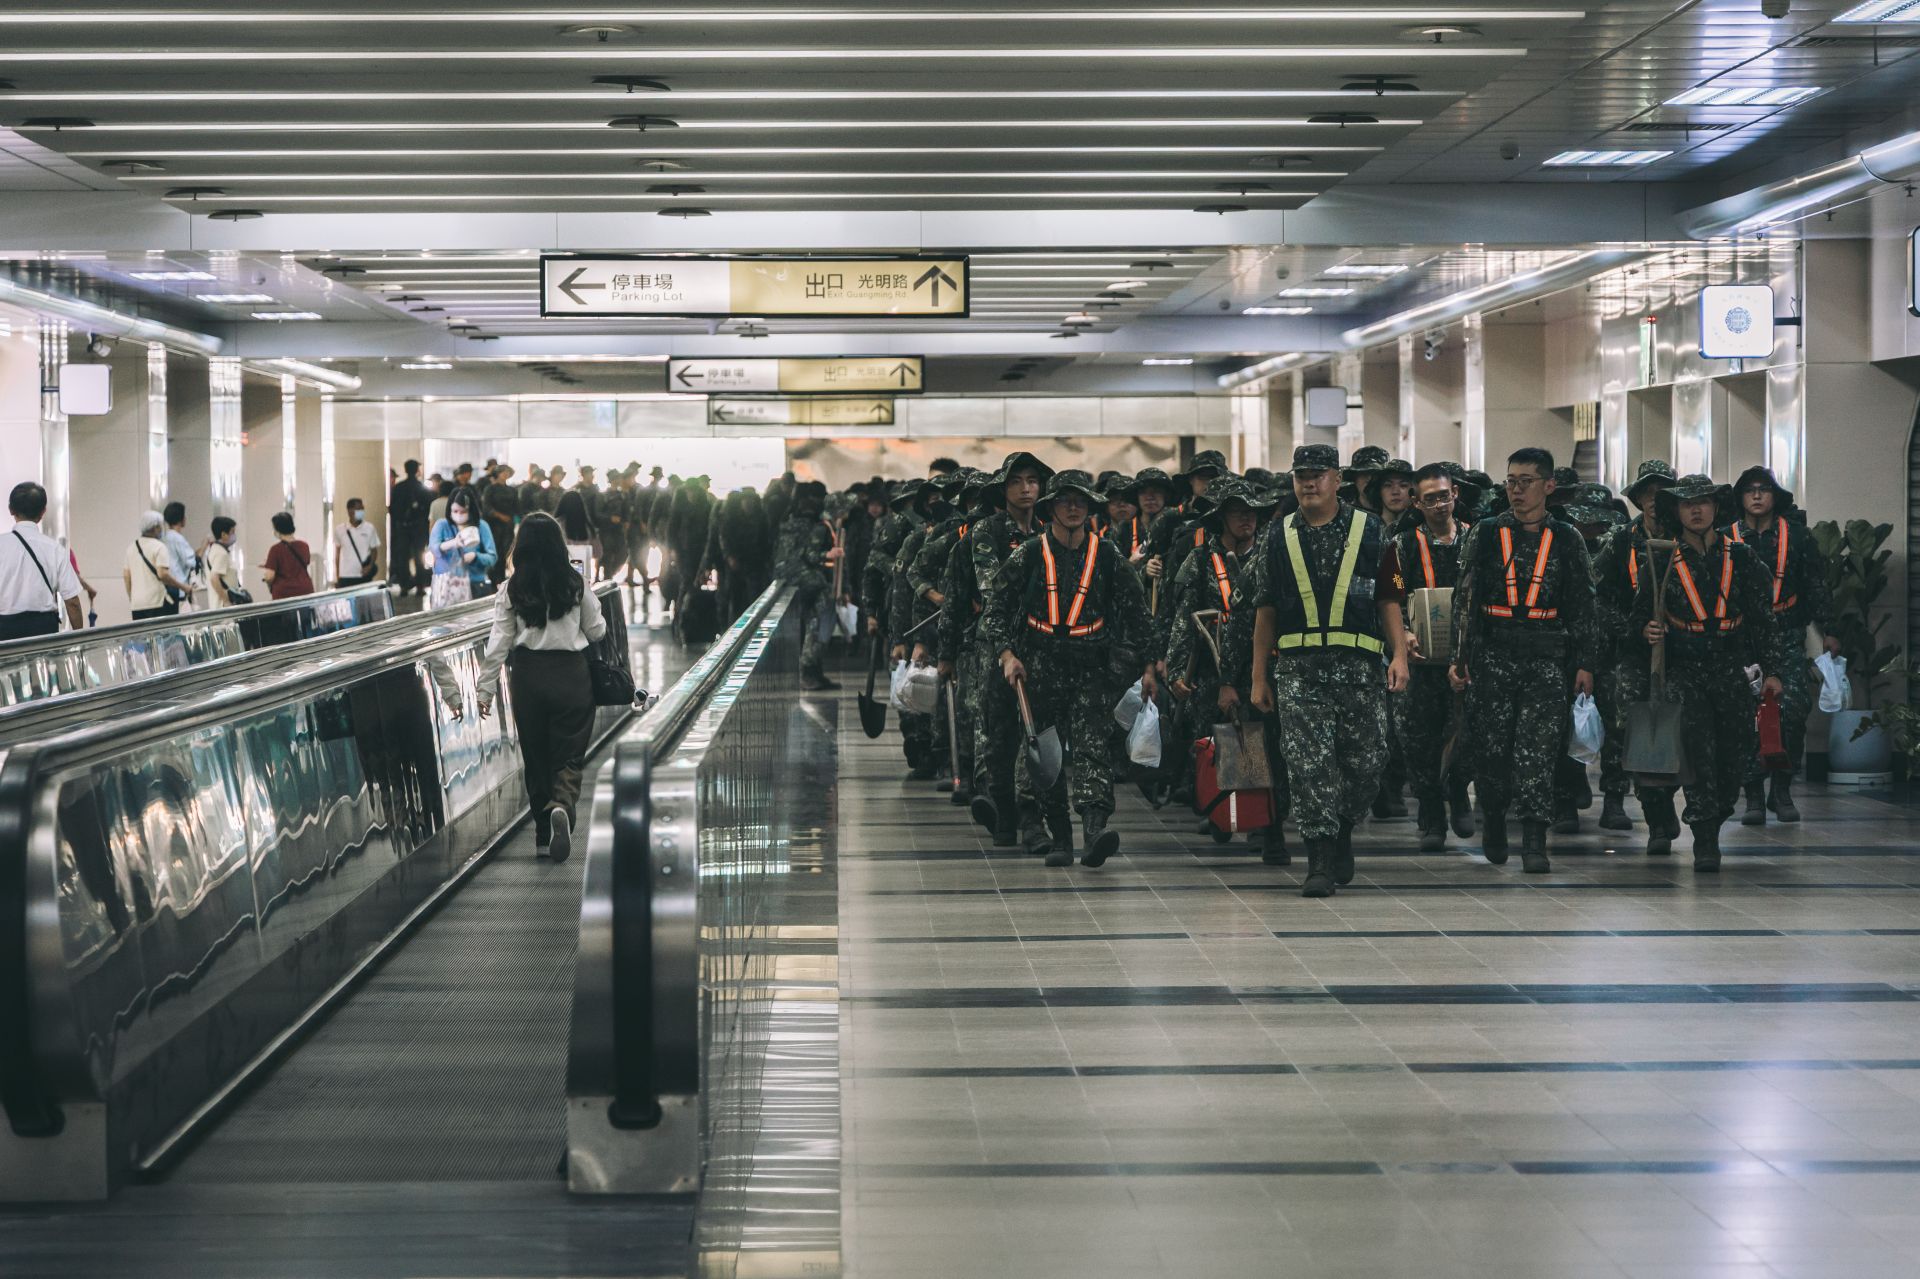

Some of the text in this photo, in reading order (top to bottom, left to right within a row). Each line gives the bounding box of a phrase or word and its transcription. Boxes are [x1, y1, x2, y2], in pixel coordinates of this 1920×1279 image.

[612, 273, 674, 290] 停車場
[806, 273, 908, 299] 出口 光明路
[612, 291, 683, 302] Parking Lot
[847, 291, 893, 300] Guangming
